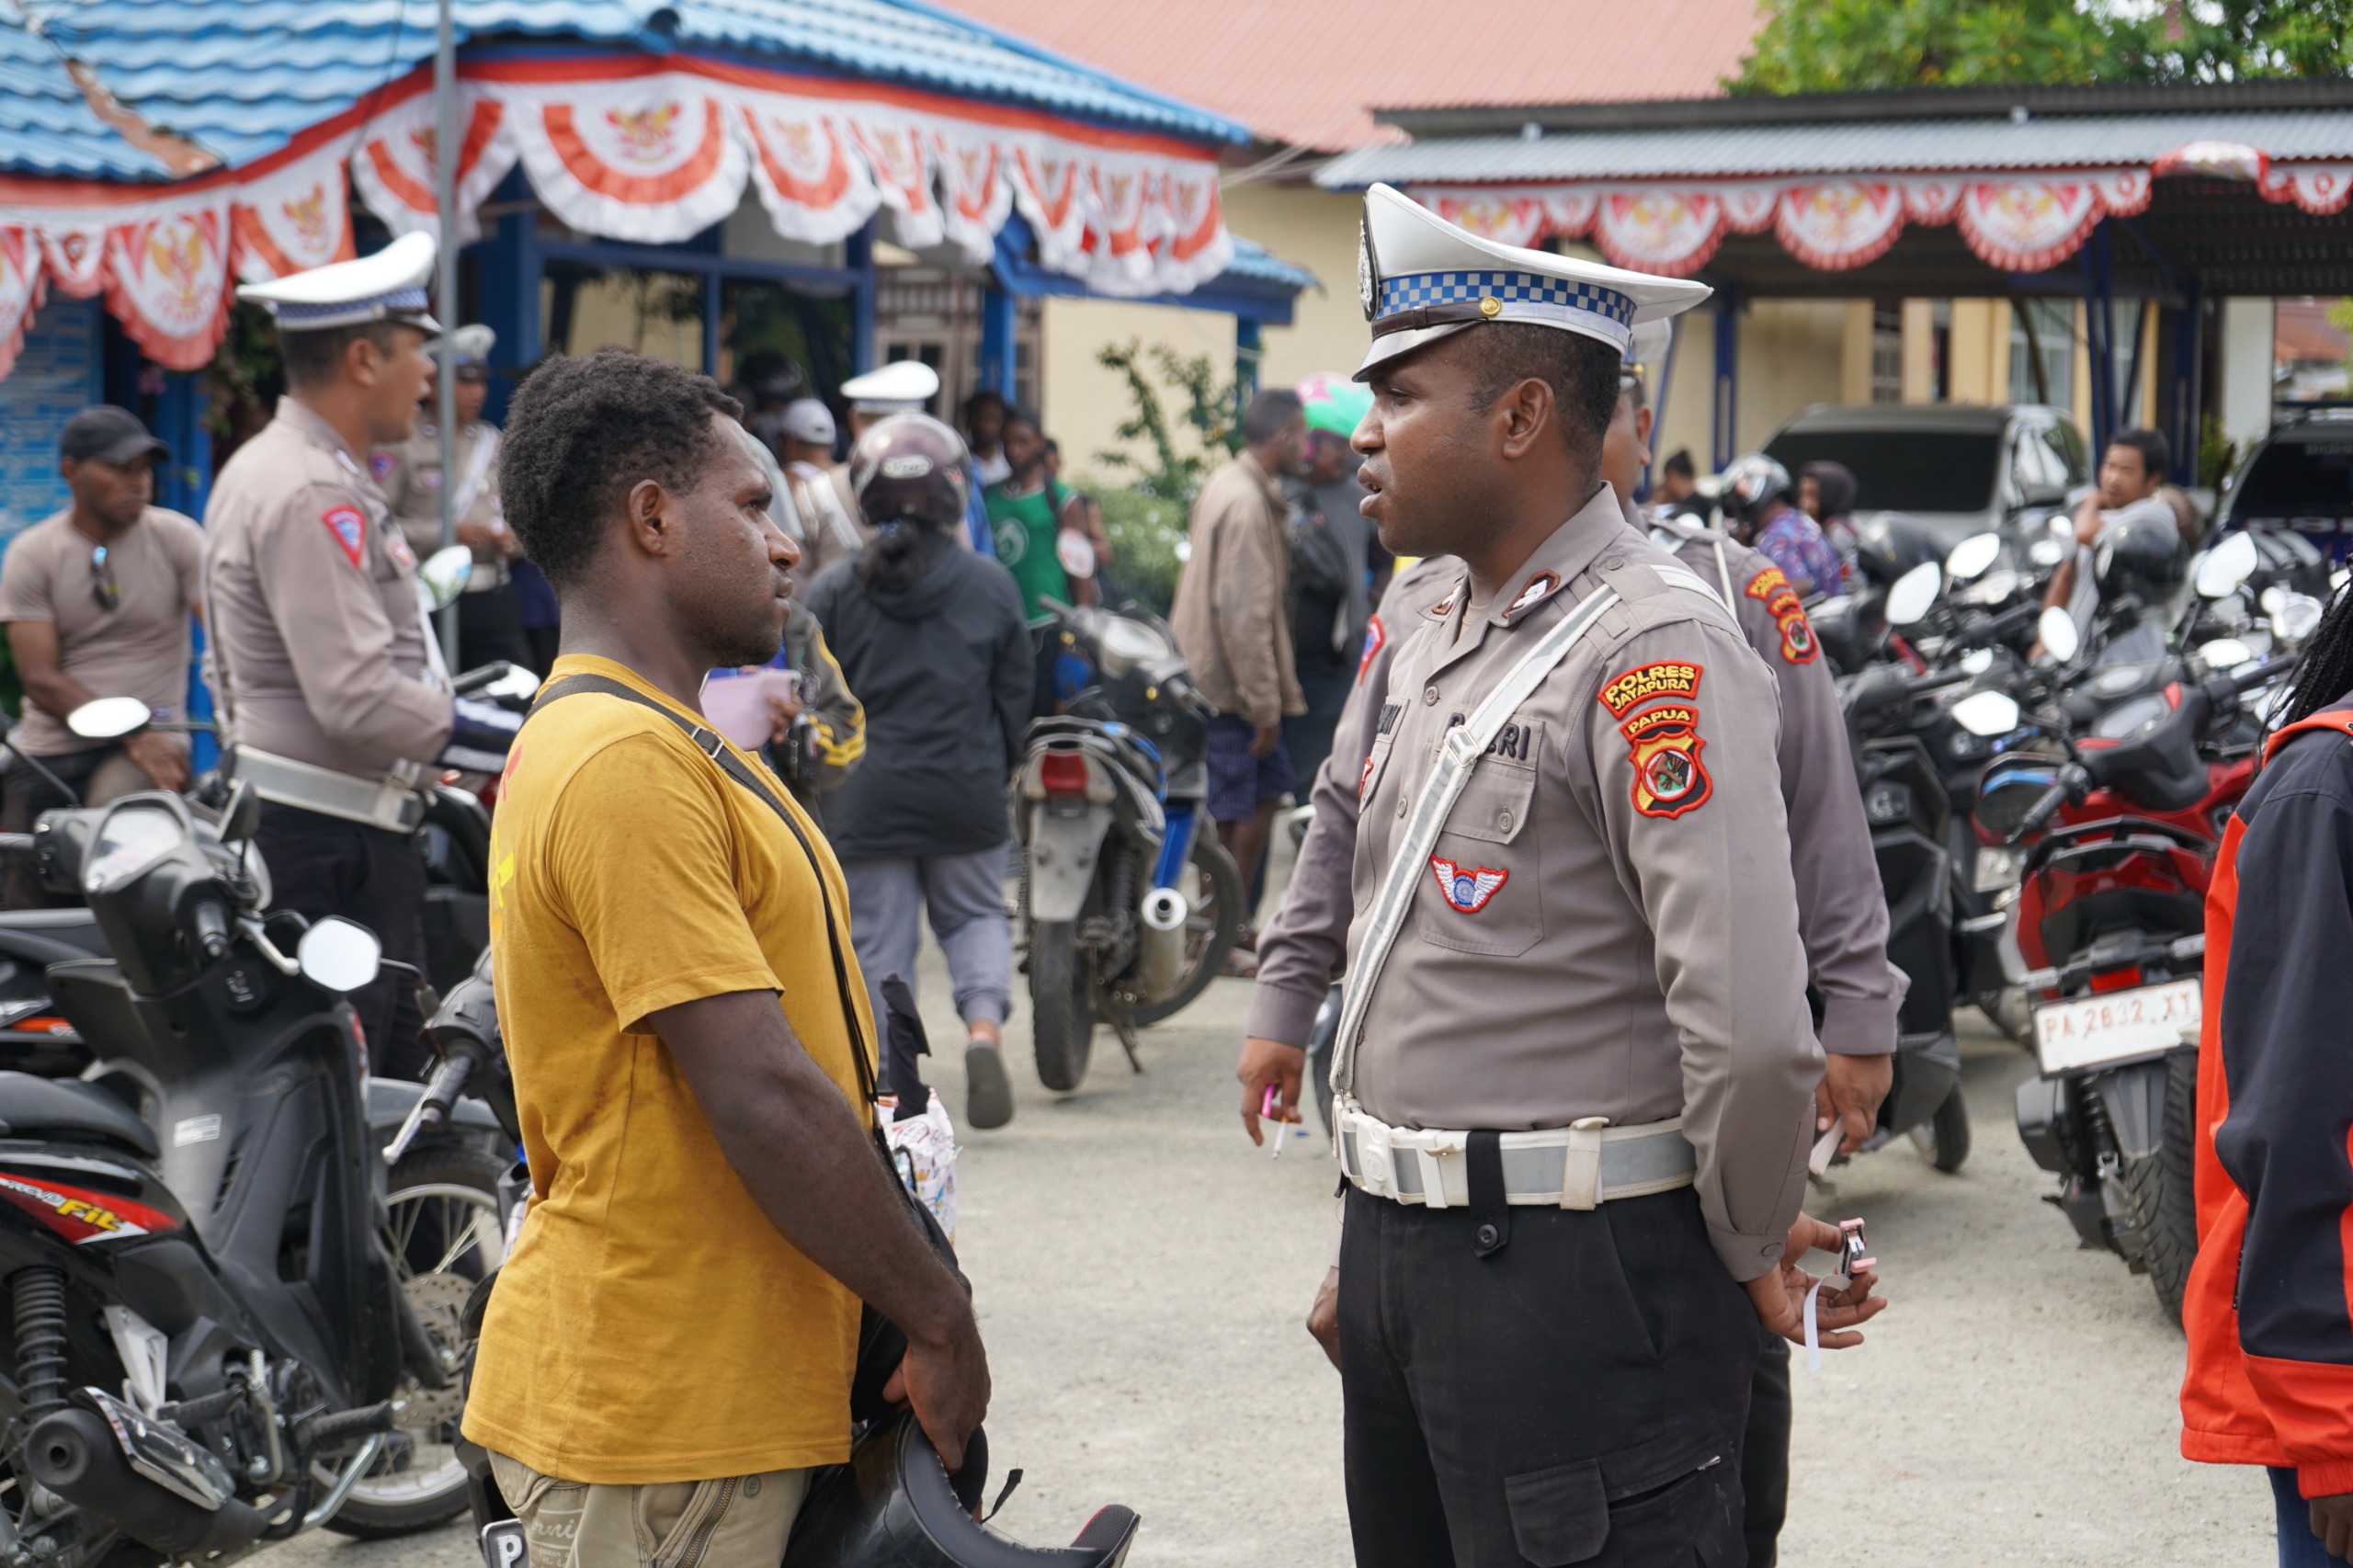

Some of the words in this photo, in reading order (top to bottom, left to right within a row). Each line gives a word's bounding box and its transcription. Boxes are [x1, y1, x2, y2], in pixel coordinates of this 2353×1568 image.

[1605, 665, 1695, 703] POLRES
[1614, 678, 1690, 710] JAYAPURA
[1446, 712, 1531, 761] PRI
[1628, 710, 1690, 733] PAPUA
[56, 1198, 124, 1233] Fit
